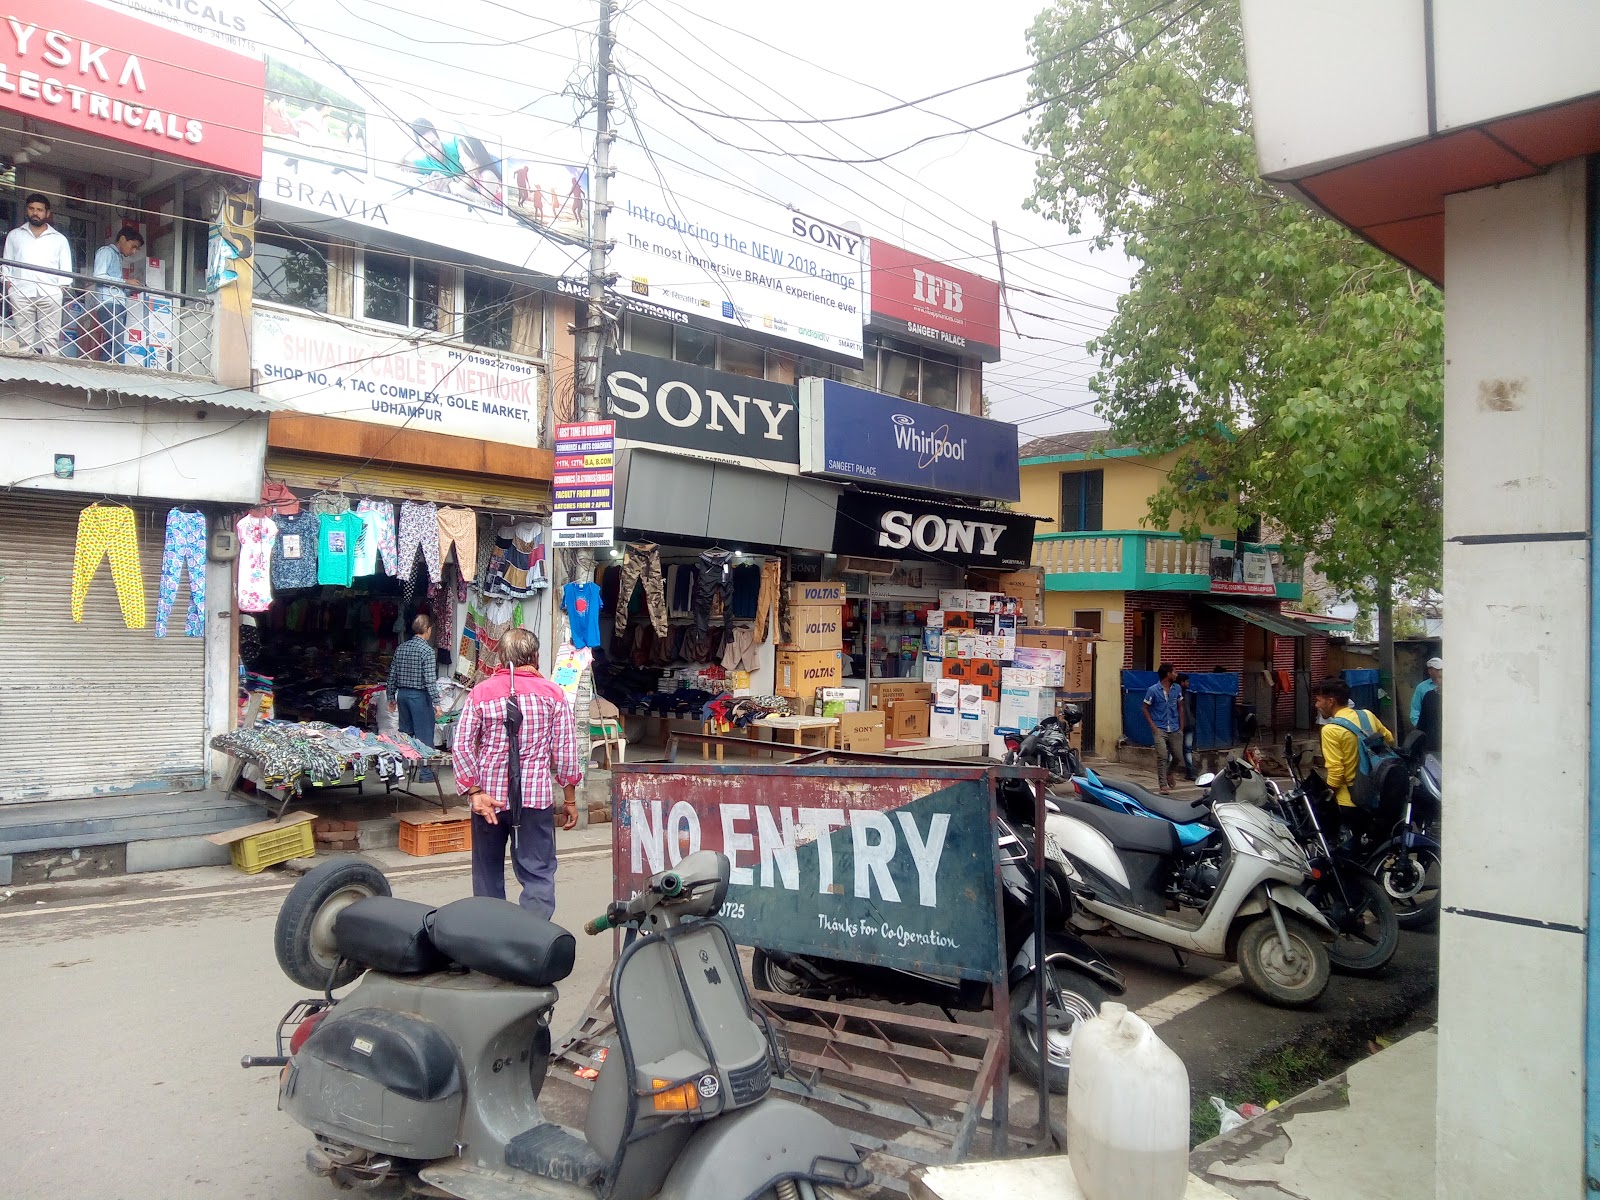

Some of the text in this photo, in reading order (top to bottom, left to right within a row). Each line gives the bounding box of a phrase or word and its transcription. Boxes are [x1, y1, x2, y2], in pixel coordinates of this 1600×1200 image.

[277, 177, 389, 226] BRAVIA
[627, 199, 856, 291] Introducing the NEW 2018 range
[791, 216, 859, 257] SONY
[626, 232, 857, 316] The most immersive BRAVIA experience ever
[912, 267, 963, 313] IFB
[907, 321, 966, 348] SANGEET PALACE
[283, 333, 531, 405] SHIVALIK CABLE TV NETWORK
[448, 350, 532, 375] PH 01992-270910
[264, 363, 531, 423] SHOP NO. 4, TAC COMPLEX, GOLE MARKET,
[607, 370, 794, 441] SONY
[371, 399, 443, 422] UDHAMPUR
[893, 424, 964, 463] Whirlpool
[829, 459, 877, 477] SANGEET PALACE
[555, 488, 610, 499] FACULTY FROM JAMMU
[576, 501, 591, 509] FROM
[595, 501, 610, 509] APRIL
[878, 510, 1008, 557] SONY
[791, 562, 818, 573] SONY
[804, 588, 840, 600] VOLTAS
[805, 622, 837, 635] VOLTAS
[803, 667, 836, 681] VOLTAS
[1076, 642, 1084, 688] Whirlpool
[854, 726, 874, 734] SONY
[630, 799, 952, 909] NO ENTRY
[818, 913, 858, 936] Thanks
[860, 917, 878, 936] For
